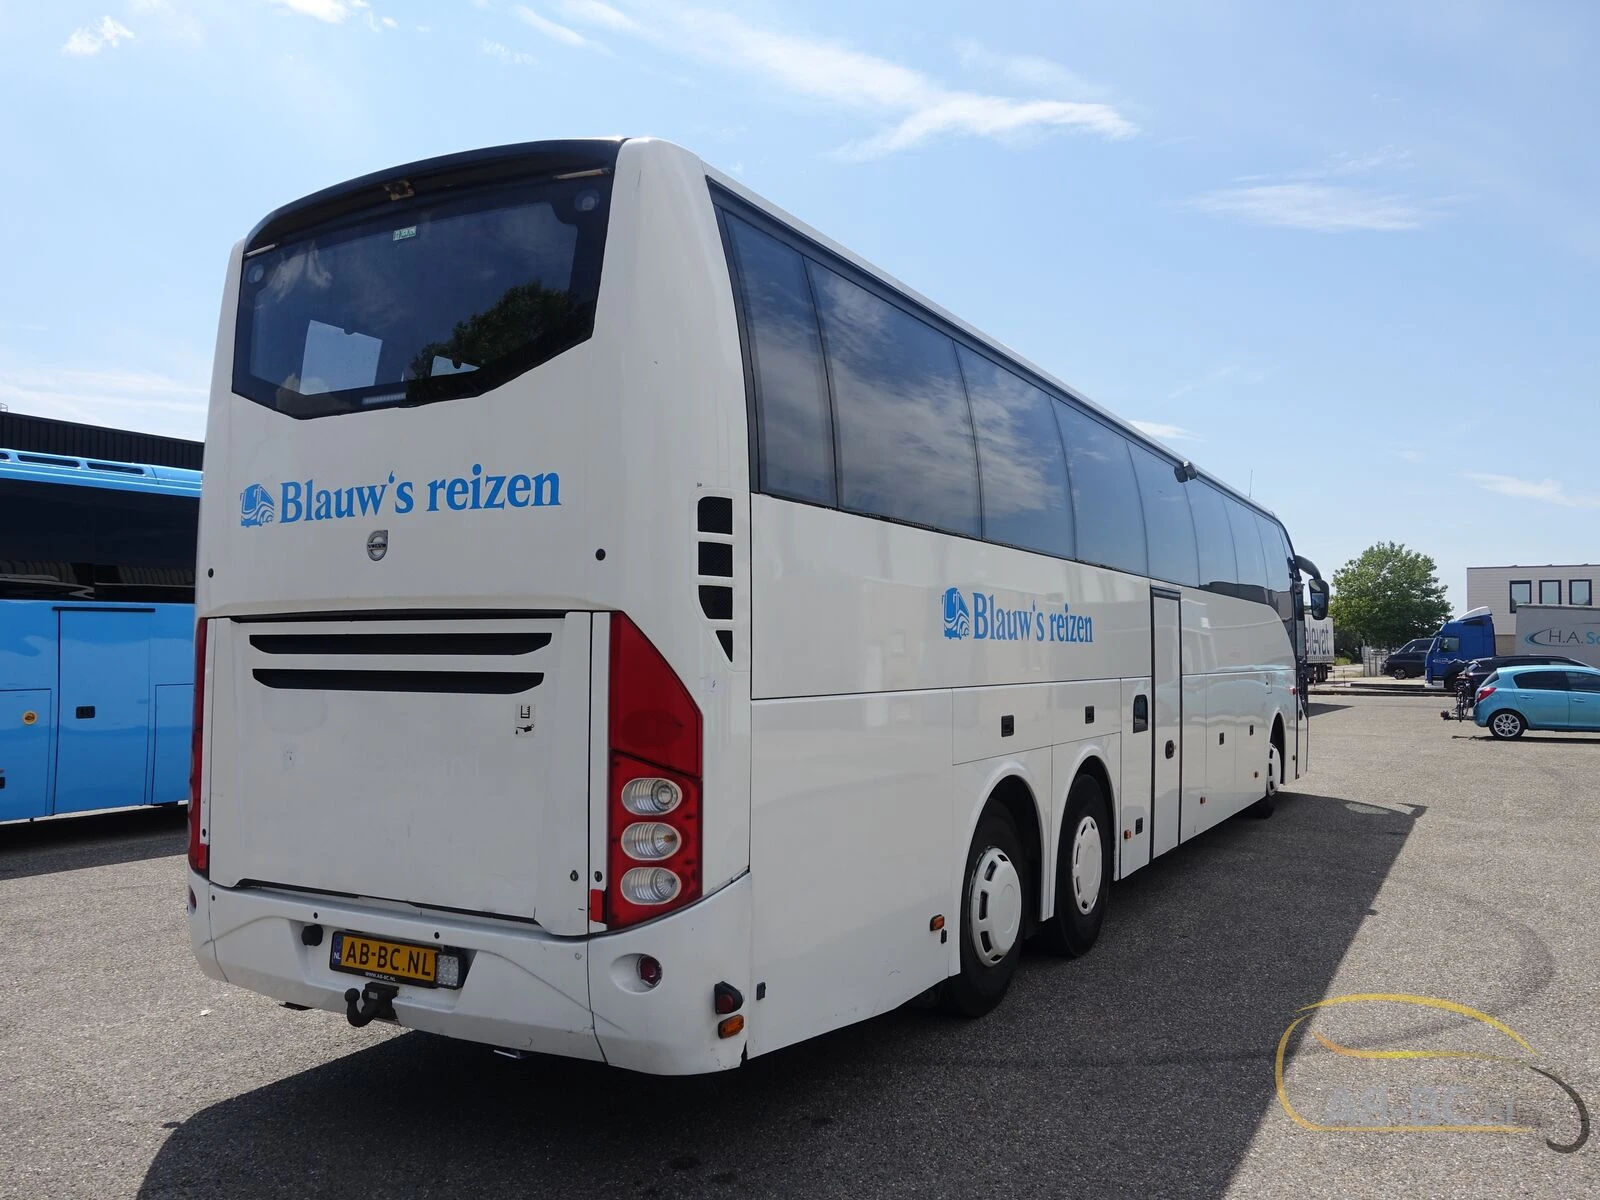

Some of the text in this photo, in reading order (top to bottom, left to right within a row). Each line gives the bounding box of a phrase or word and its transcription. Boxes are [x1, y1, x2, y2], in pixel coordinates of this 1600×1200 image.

[279, 463, 563, 524] Blauw's reizen
[972, 592, 1094, 643] Blauw's reizen
[1549, 629, 1584, 644] H.A.
[333, 951, 342, 960] NL
[345, 941, 431, 977] AB-BC.NL
